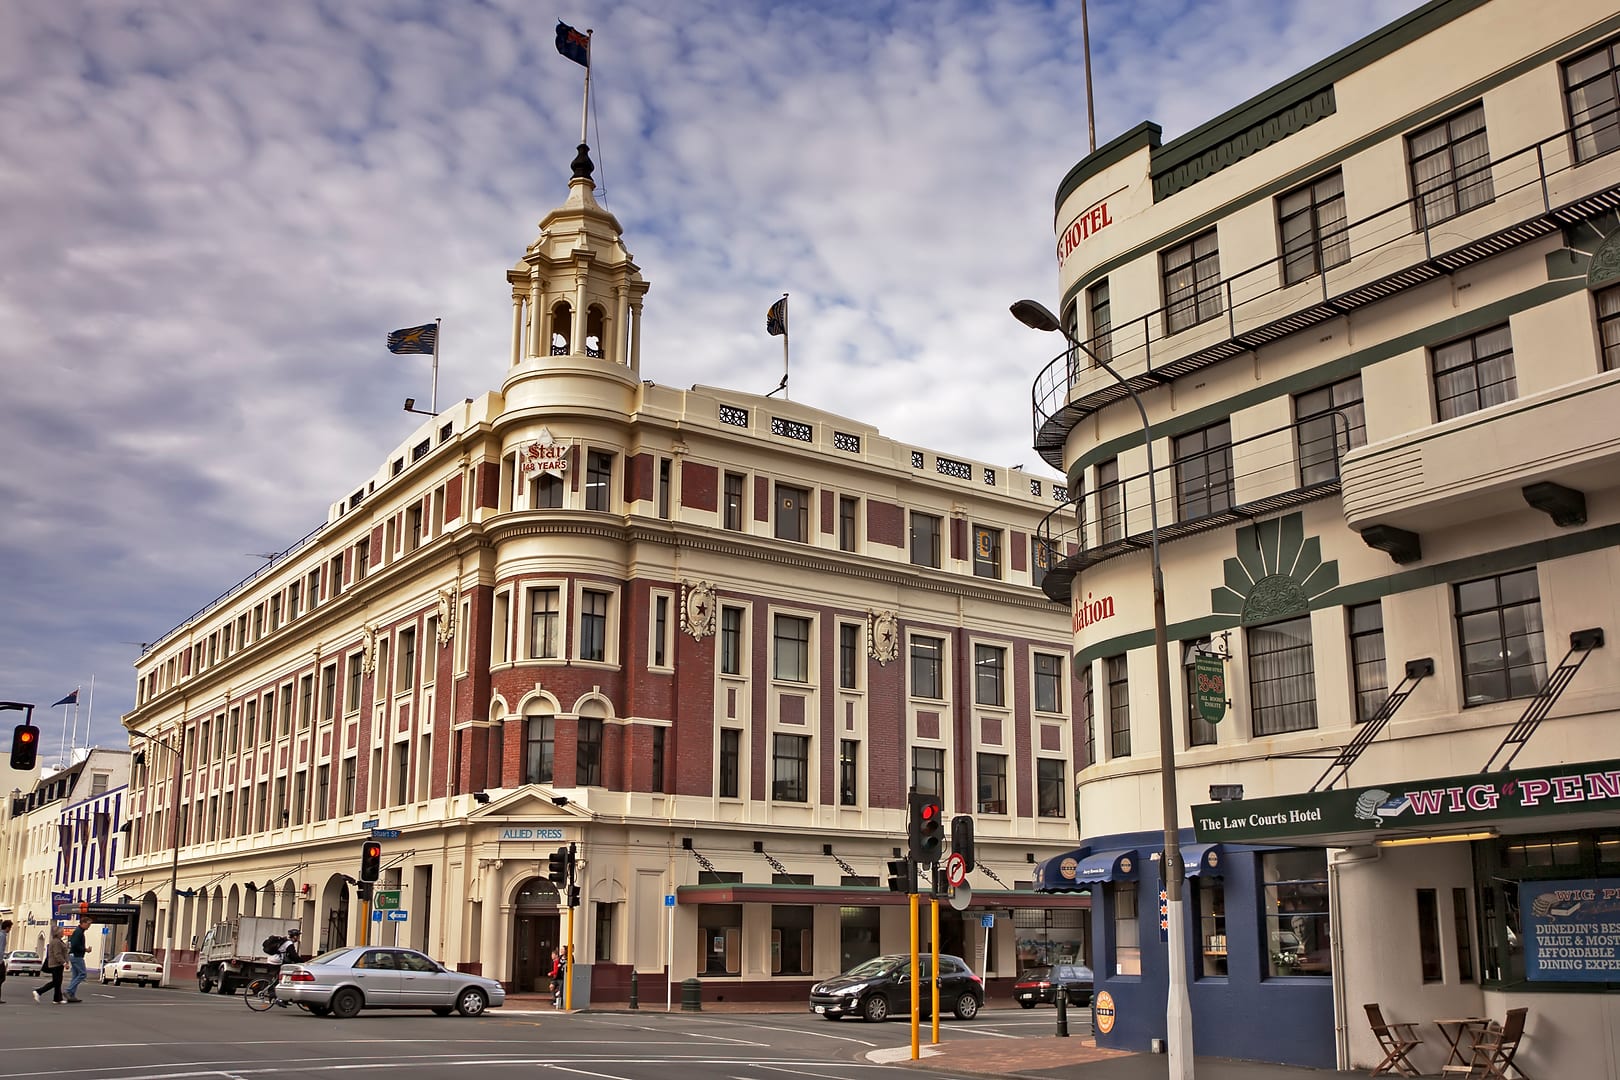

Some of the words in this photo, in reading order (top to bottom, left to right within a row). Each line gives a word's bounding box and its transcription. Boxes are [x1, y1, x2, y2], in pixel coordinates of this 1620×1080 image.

[1064, 202, 1113, 259] HOTEL
[528, 442, 566, 459] Star
[537, 460, 567, 470] YEARS
[1404, 784, 1500, 815] WIG
[1518, 771, 1620, 806] PEN
[1200, 818, 1221, 831] The
[1223, 816, 1247, 829] Law
[1249, 811, 1287, 827] Courts
[1289, 808, 1321, 823] Hotel
[503, 829, 533, 839] ALLIED
[536, 829, 562, 839] PRESS
[1555, 889, 1596, 901] WIG
[1535, 923, 1599, 935] DUNEDIN'S
[1536, 935, 1573, 946] VALUE
[1574, 935, 1584, 946] &
[1585, 935, 1620, 946] MOST
[1538, 947, 1615, 958] AFFORDABLE
[1538, 959, 1583, 970] DINING
